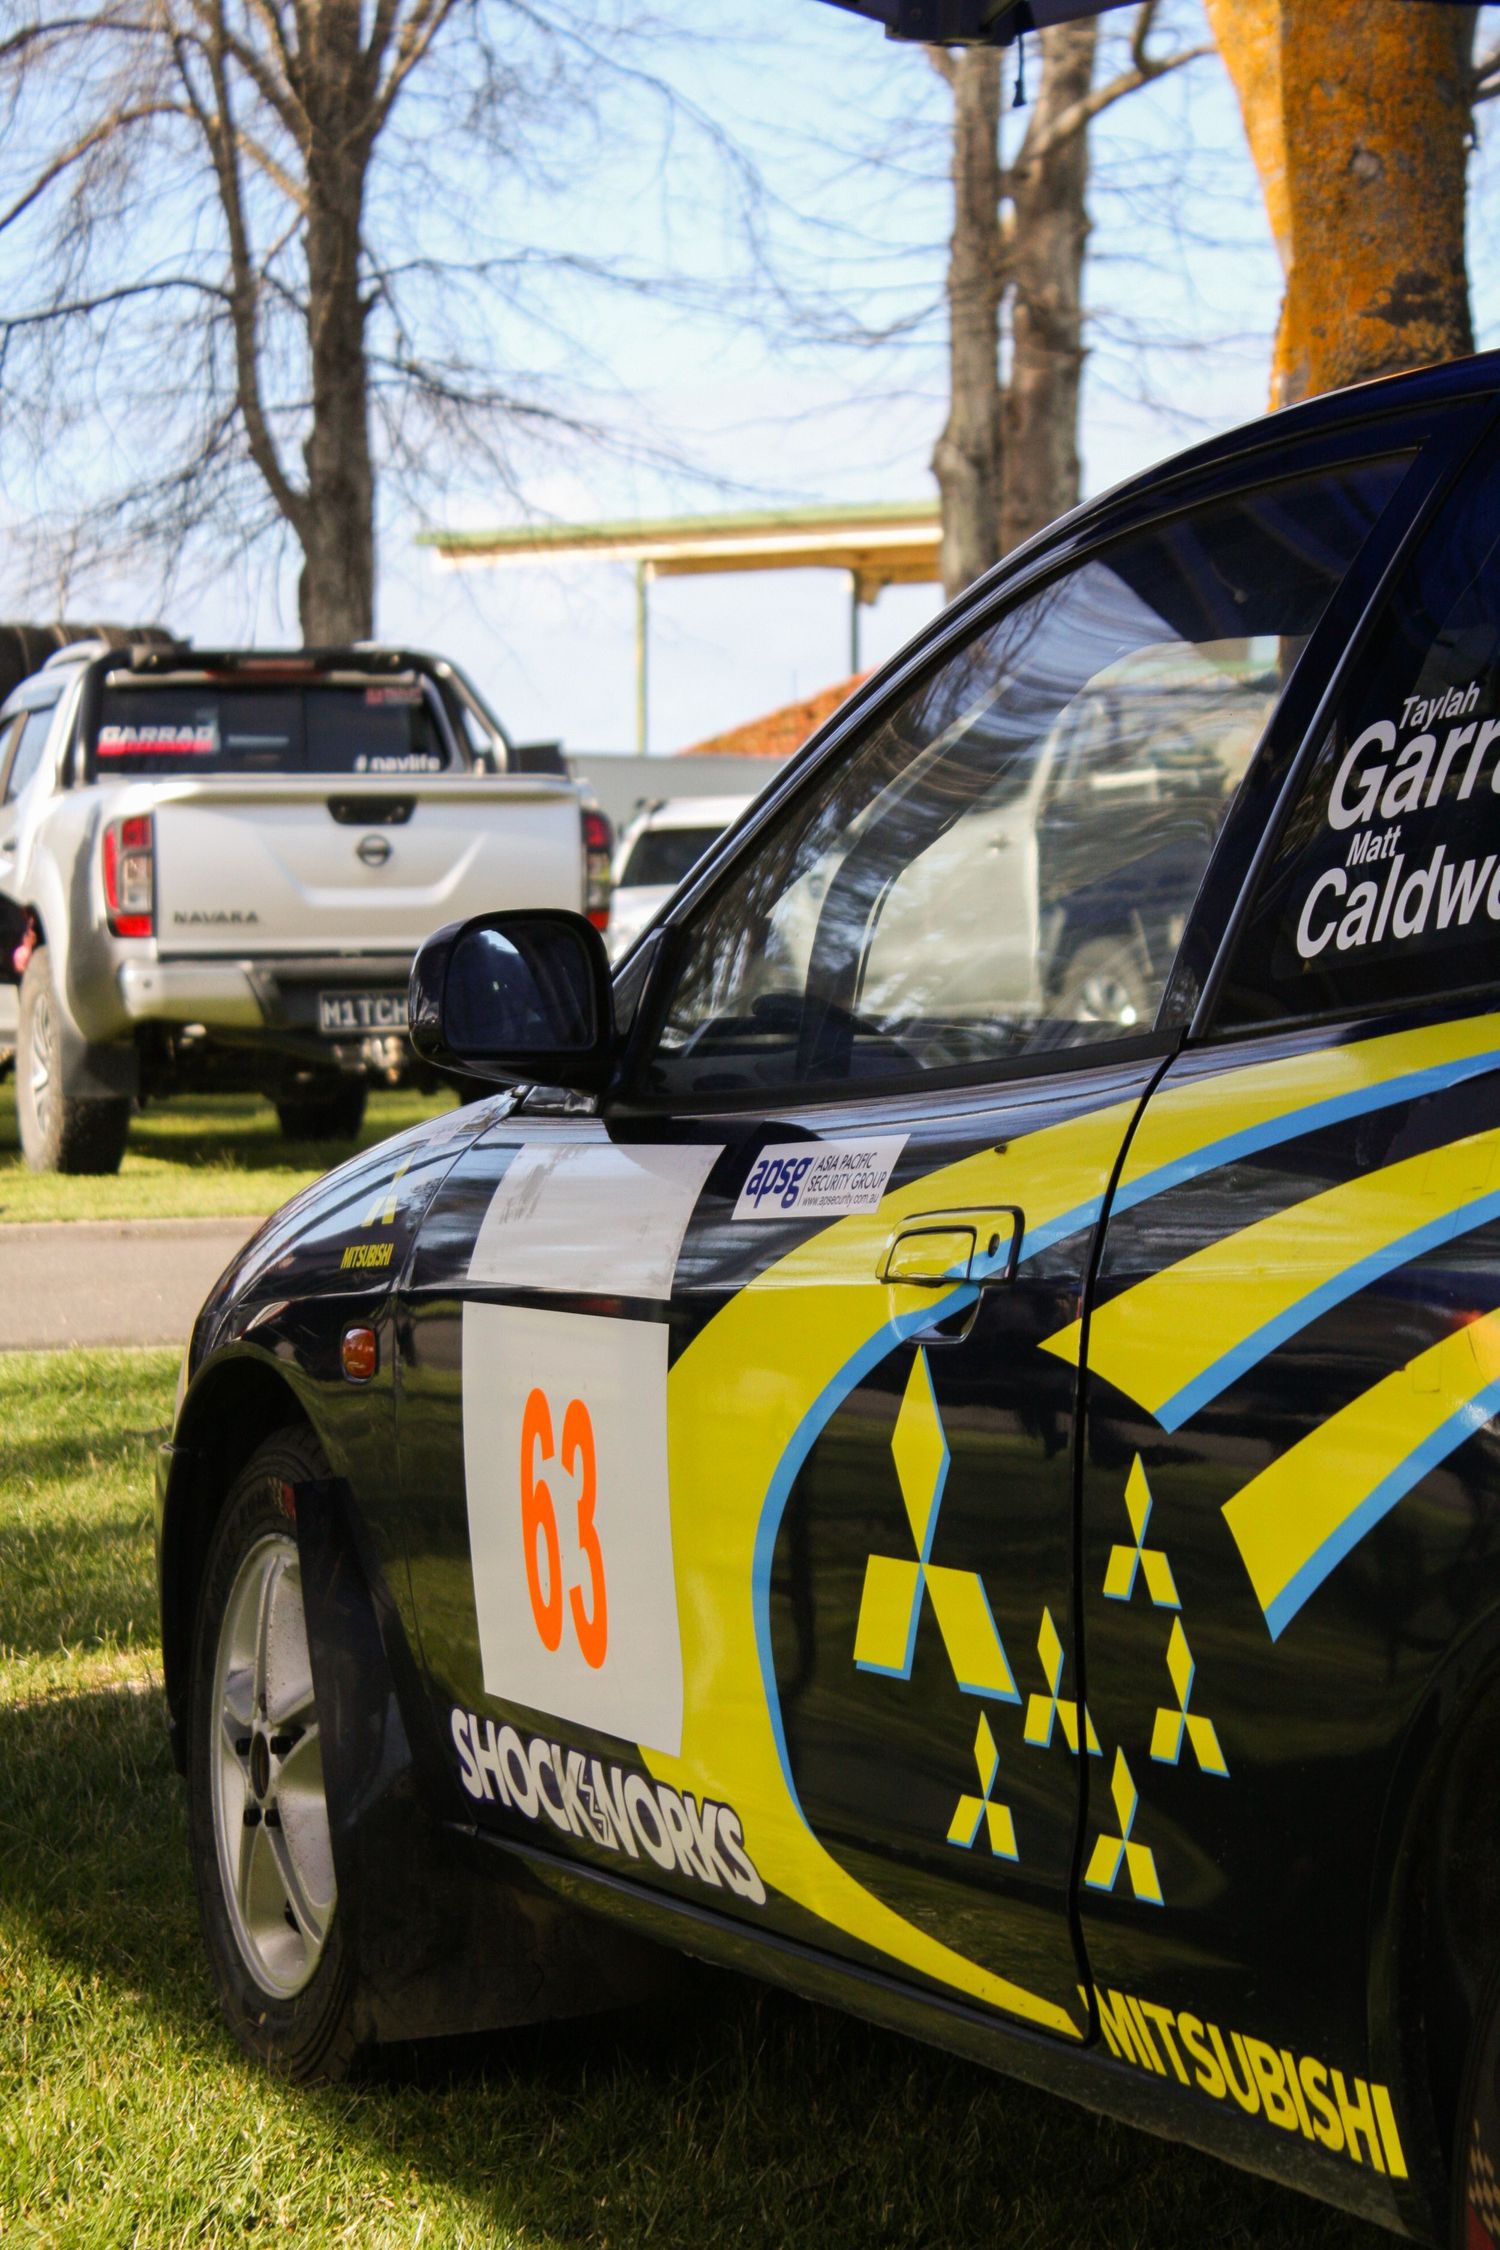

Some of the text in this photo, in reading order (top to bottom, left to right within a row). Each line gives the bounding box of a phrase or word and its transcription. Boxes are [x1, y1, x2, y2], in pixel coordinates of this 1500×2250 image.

[1399, 681, 1481, 732] Taylah
[1328, 717, 1500, 830] Garr
[1346, 825, 1402, 867] Matt
[745, 1157, 814, 1209] apsg
[807, 1170, 888, 1192] SECURITY GROUP
[815, 1152, 877, 1172] ASIA PACIFIC
[801, 1193, 880, 1208] www.apsecurity.com.au
[341, 1243, 394, 1270] MITSUBISHI
[520, 1388, 608, 1670] 63
[1076, 1983, 1409, 2179] MITSUBISHI
